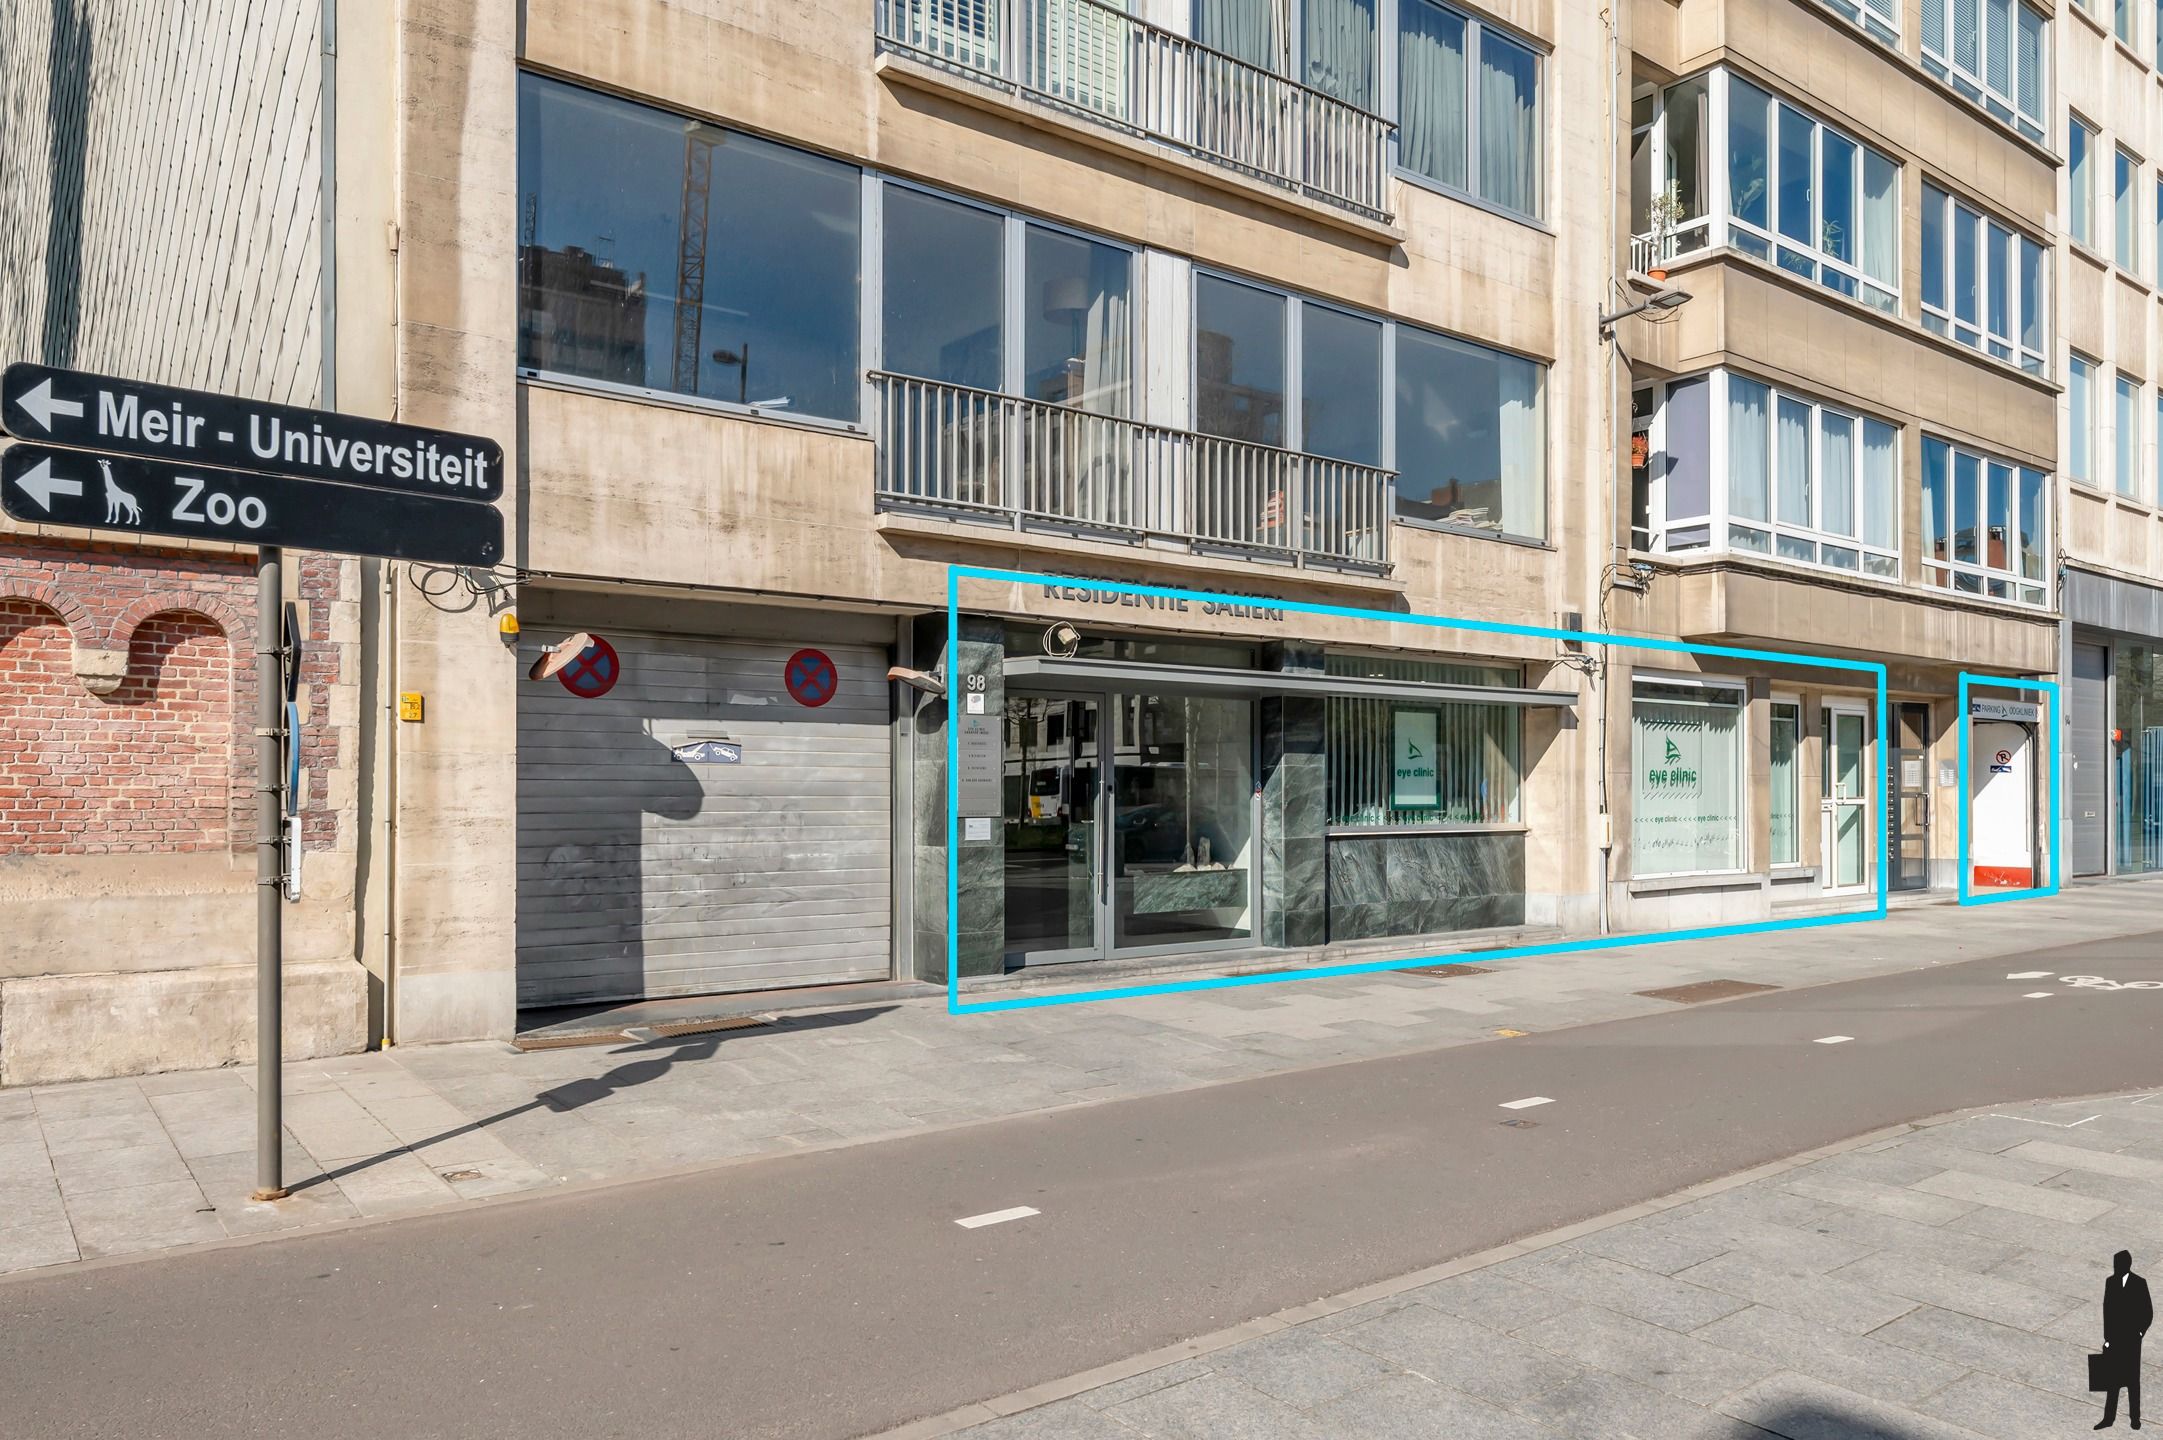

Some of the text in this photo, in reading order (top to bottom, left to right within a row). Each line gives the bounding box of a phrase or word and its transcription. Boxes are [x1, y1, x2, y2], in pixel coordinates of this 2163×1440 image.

[99, 390, 204, 448] Meir
[250, 413, 488, 489] Universiteit
[172, 477, 267, 529] Zoo
[967, 674, 986, 692] 98
[1397, 767, 1434, 779] eye clinic
[1649, 767, 1697, 785] eye clinic
